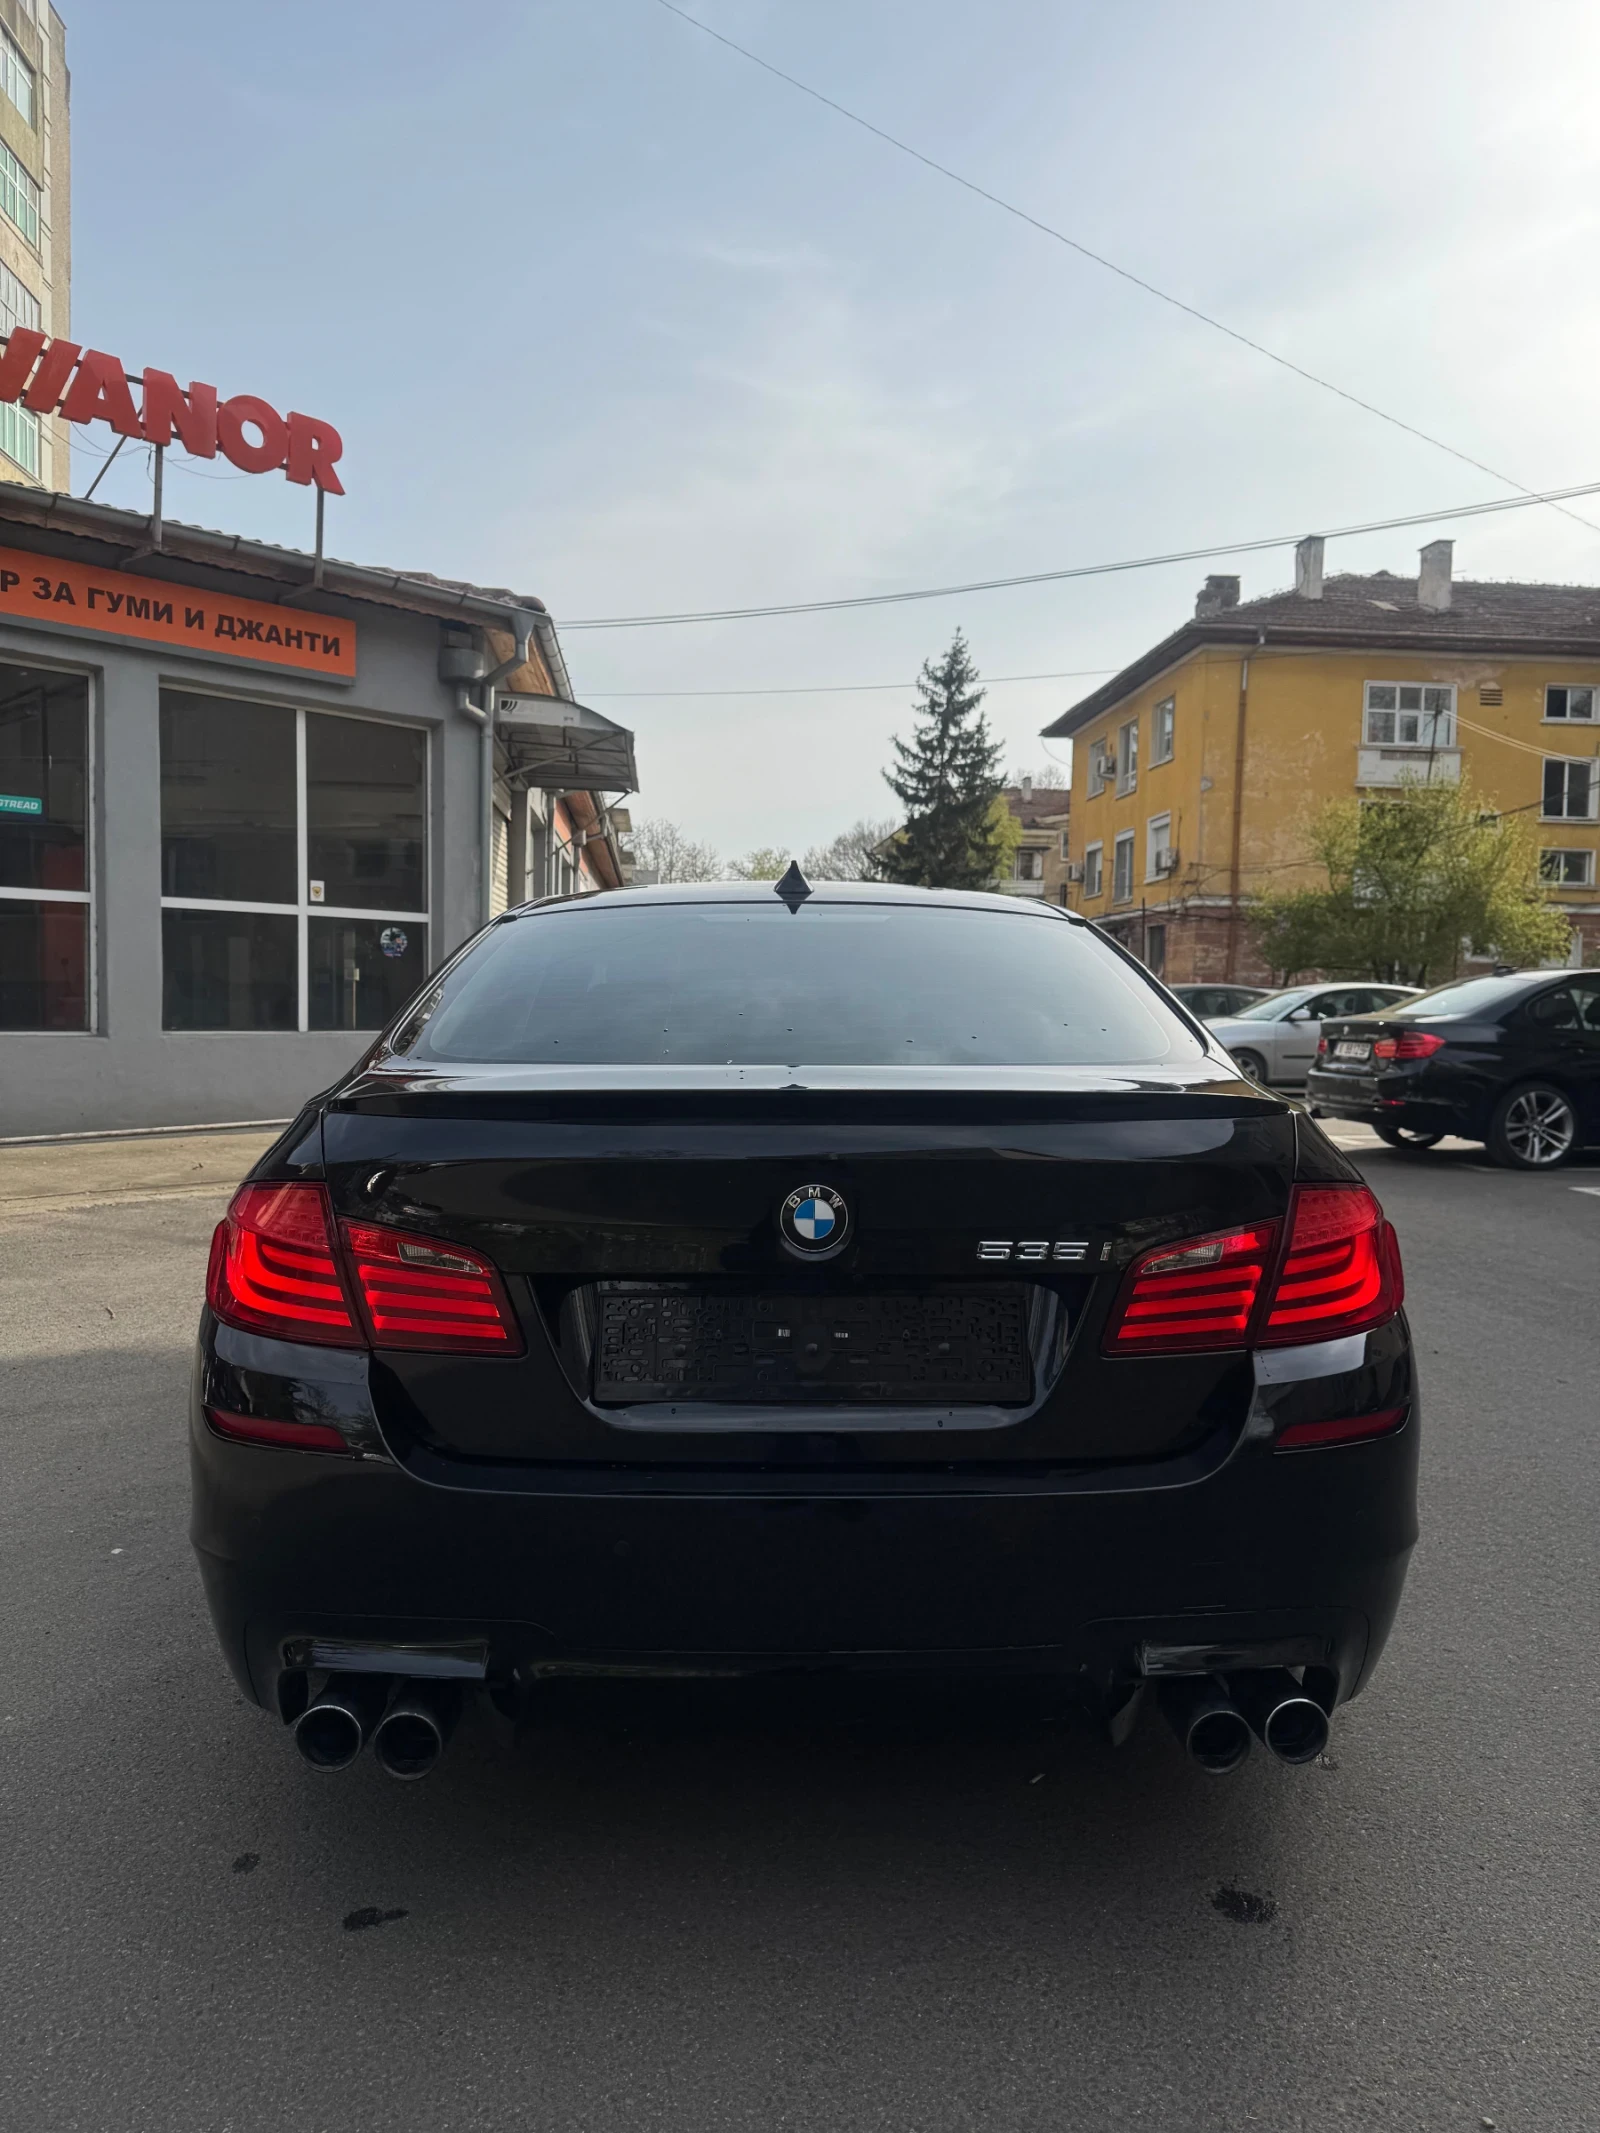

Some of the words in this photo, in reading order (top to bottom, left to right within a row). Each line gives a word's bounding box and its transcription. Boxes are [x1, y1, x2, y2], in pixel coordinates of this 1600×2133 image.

[32, 577, 76, 605] ЗА
[87, 587, 173, 624] ГУМИ
[185, 607, 204, 630] И
[214, 614, 340, 656] ДЖАНТИ
[787, 1187, 842, 1208] BMW
